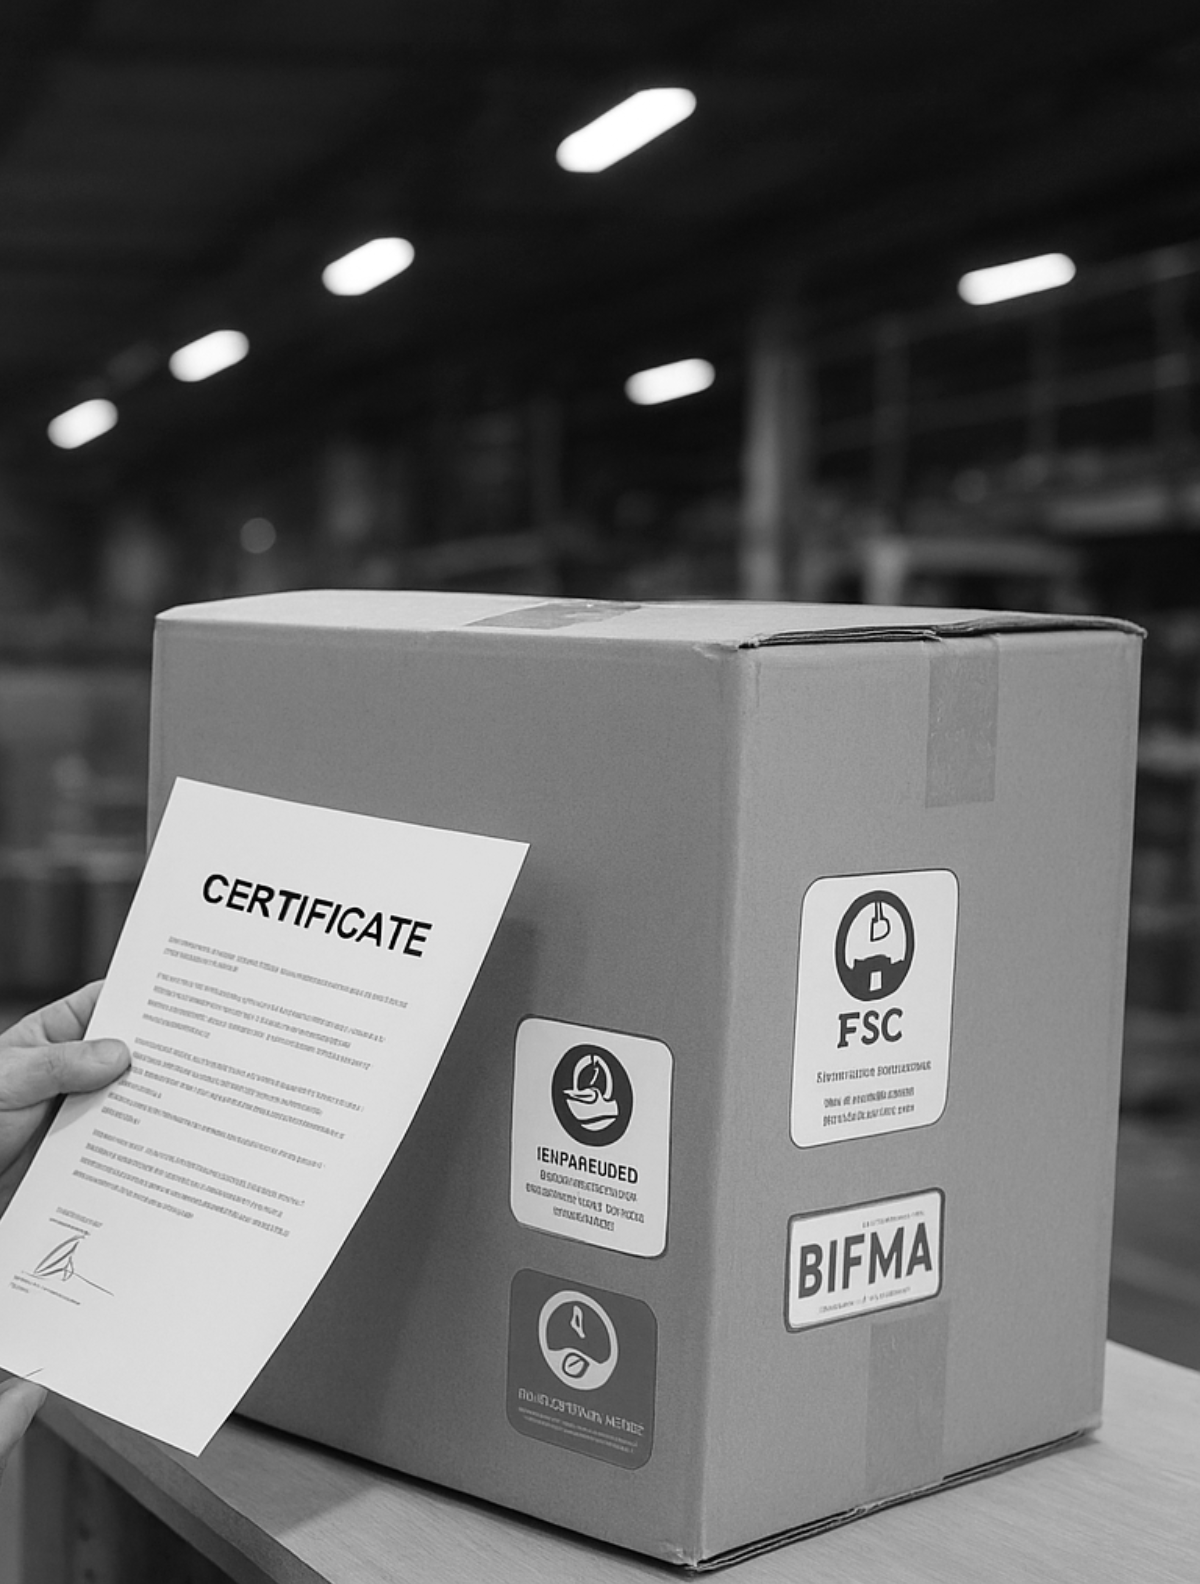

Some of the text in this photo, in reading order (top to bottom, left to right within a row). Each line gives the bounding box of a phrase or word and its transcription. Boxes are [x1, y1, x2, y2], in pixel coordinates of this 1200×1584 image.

[202, 874, 433, 958] CERTIFICATE
[837, 1007, 904, 1049] FSC
[798, 1222, 933, 1299] BIFMA
